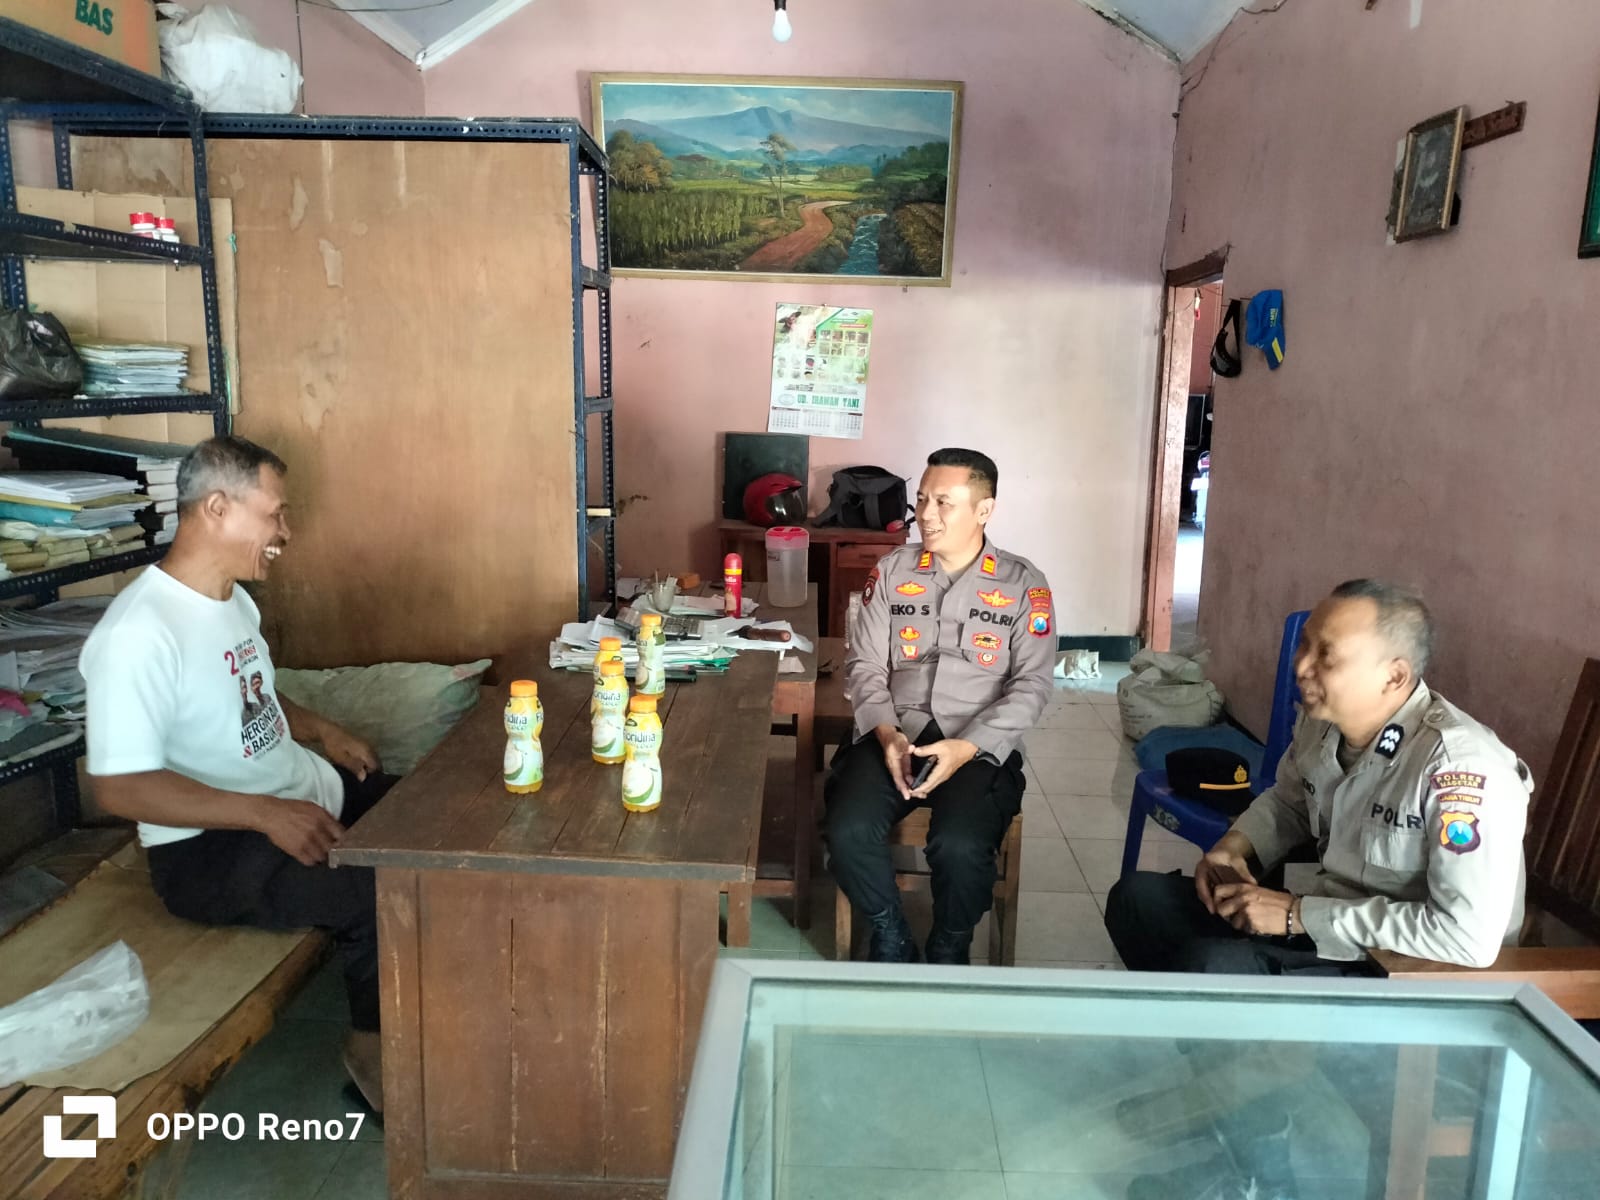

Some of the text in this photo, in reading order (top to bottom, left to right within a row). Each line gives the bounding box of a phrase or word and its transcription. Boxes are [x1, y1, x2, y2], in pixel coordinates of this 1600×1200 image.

[75, 0, 113, 36] BAS
[891, 604, 930, 616] EKO S
[969, 608, 1014, 626] POLRI
[224, 650, 240, 676] 2
[1436, 774, 1482, 784] POLRES
[1371, 803, 1422, 829] POLR
